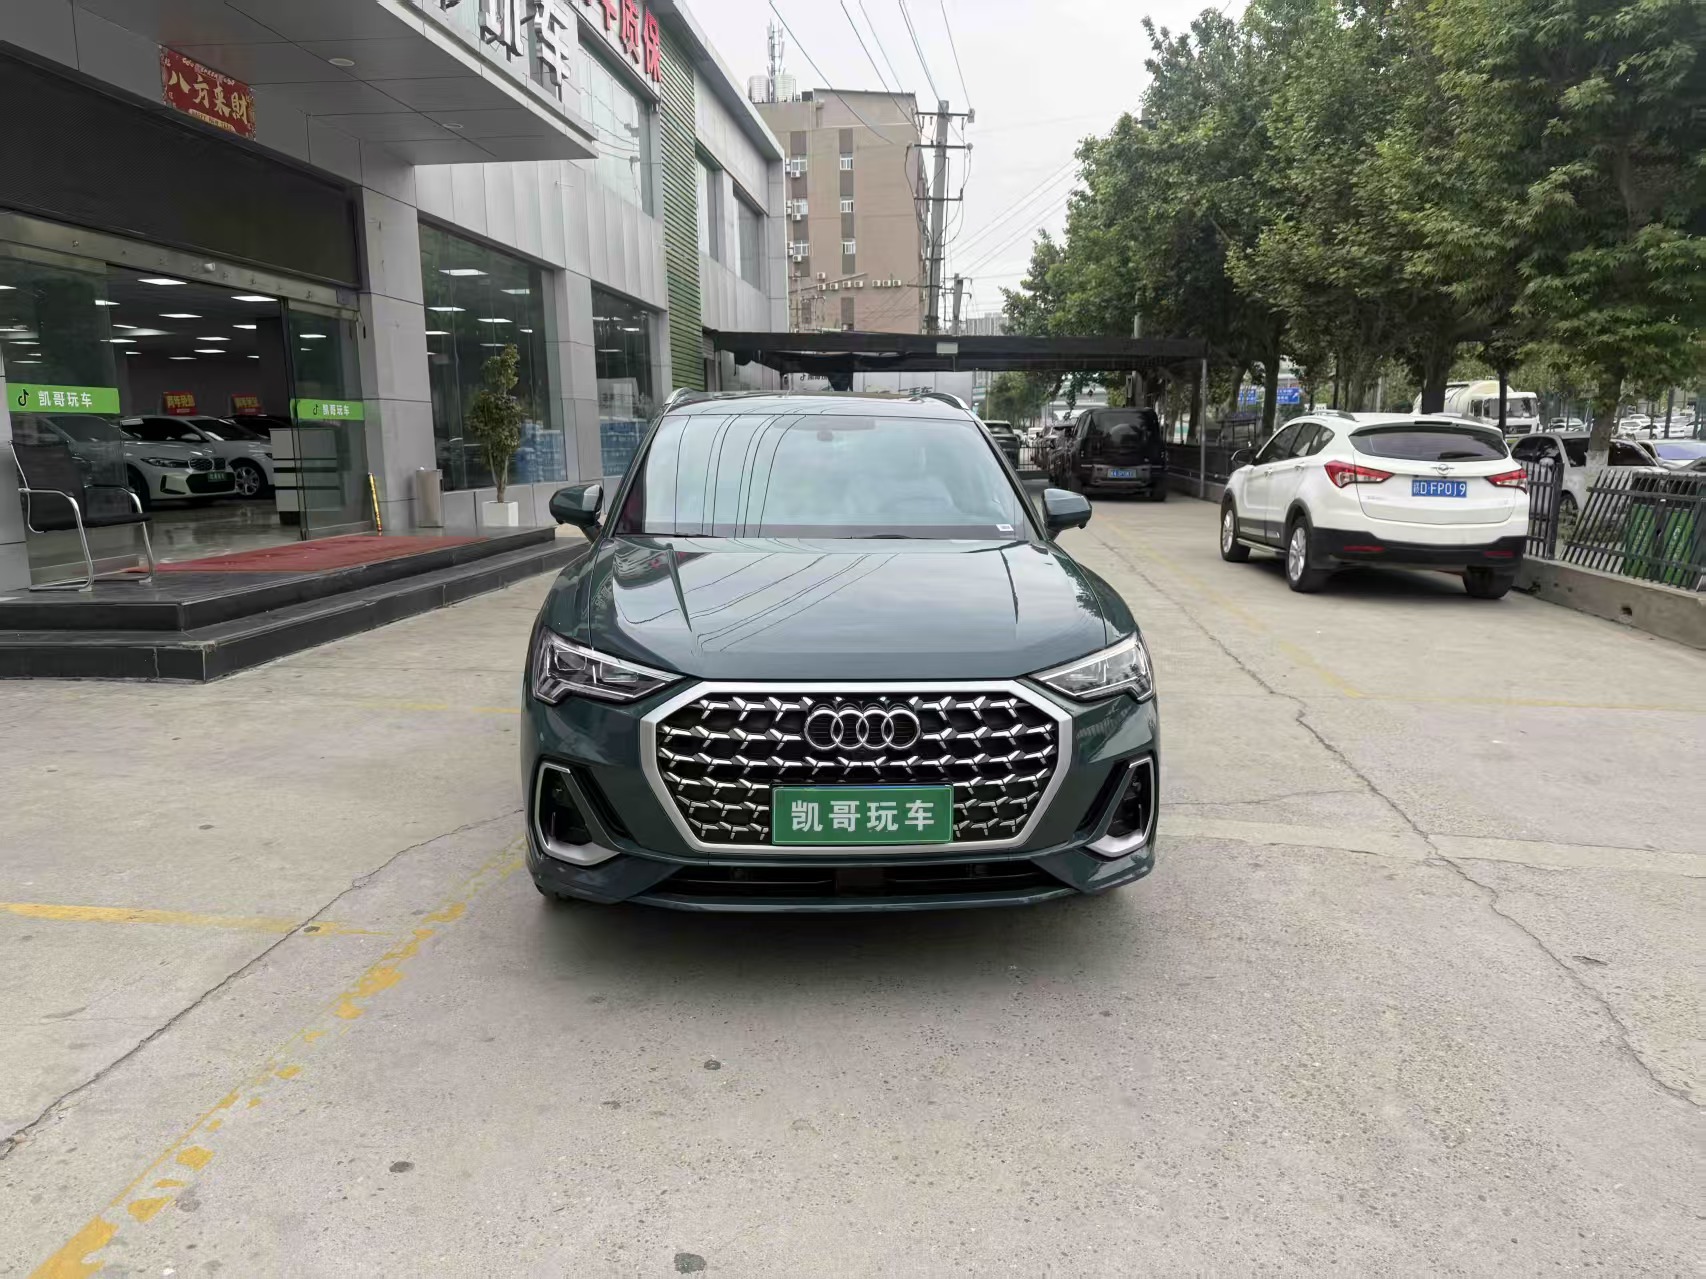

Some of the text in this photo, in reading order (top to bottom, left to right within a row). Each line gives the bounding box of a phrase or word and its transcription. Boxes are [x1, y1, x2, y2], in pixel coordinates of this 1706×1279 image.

[38, 390, 93, 408] 凯哥玩车
[322, 403, 350, 416] 凯哥玩车
[791, 799, 935, 833] 凯哥玩车
